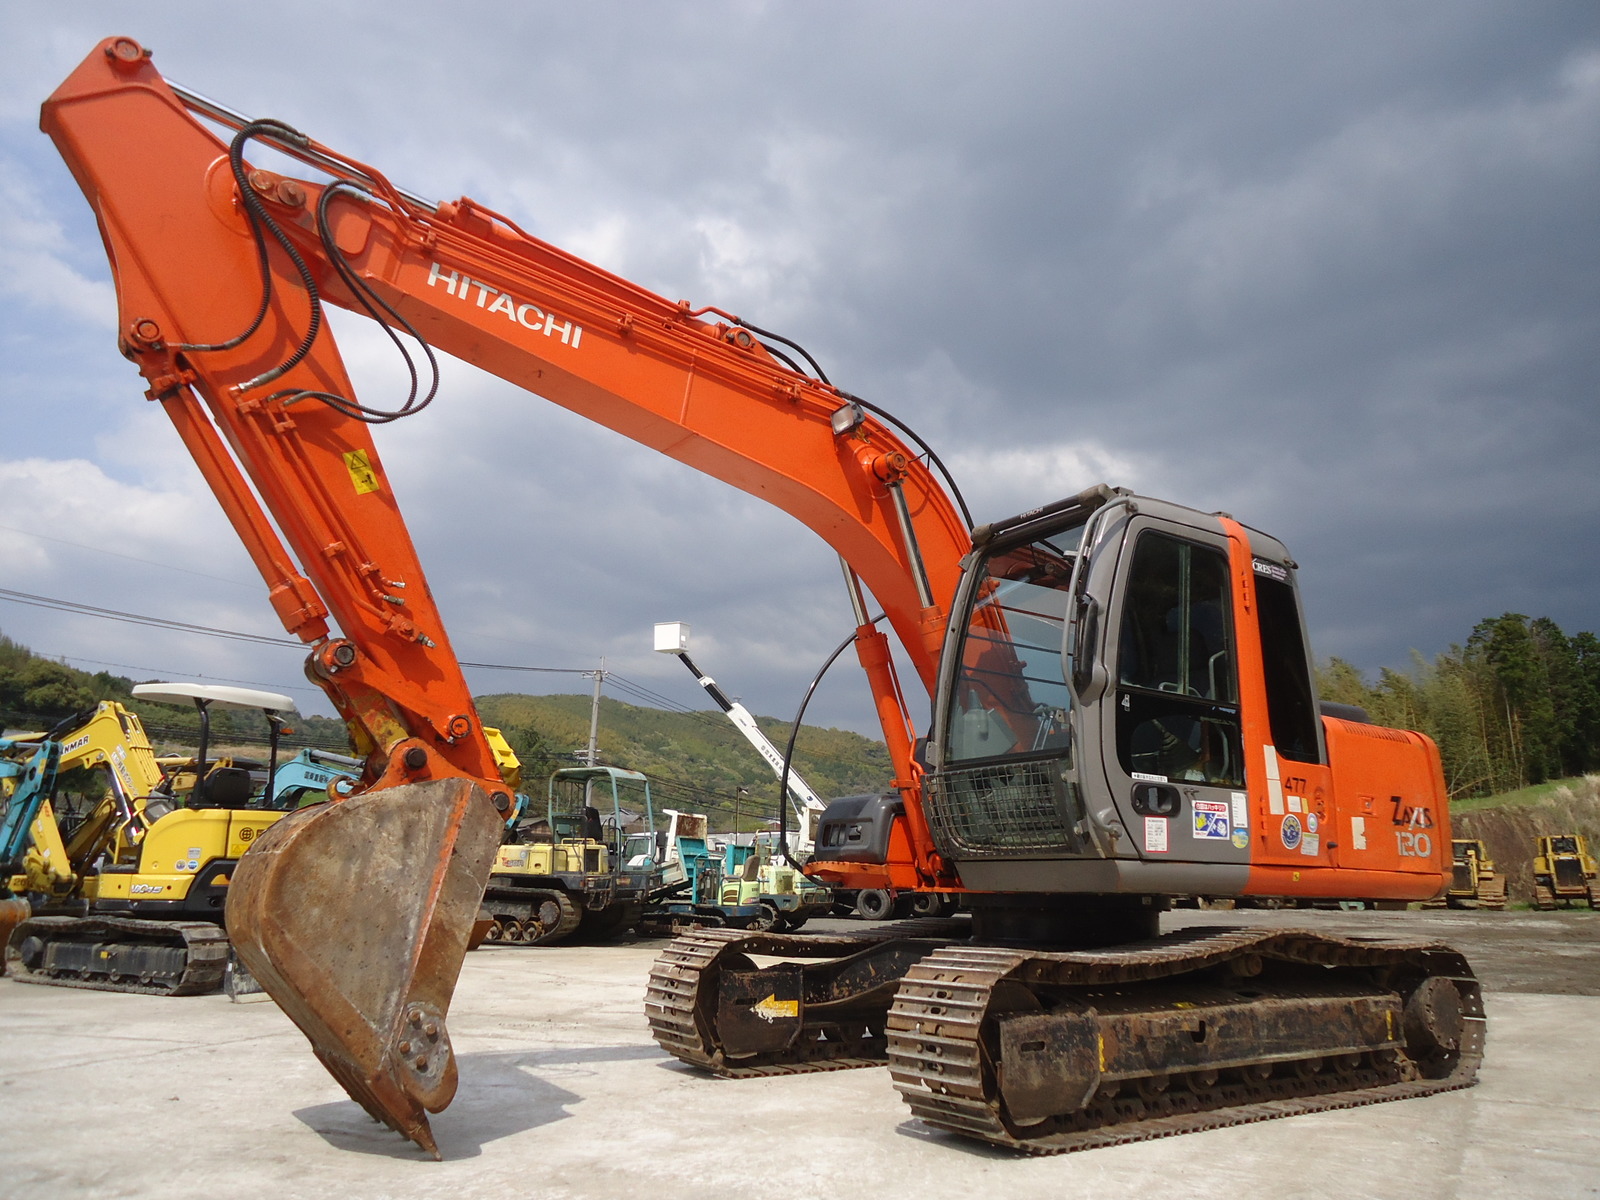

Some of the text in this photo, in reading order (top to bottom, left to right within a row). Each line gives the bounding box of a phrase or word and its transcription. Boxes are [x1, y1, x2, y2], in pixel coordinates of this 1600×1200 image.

[427, 262, 582, 349] HITACHI
[1285, 777, 1306, 793] 477
[1395, 831, 1431, 857] 120
